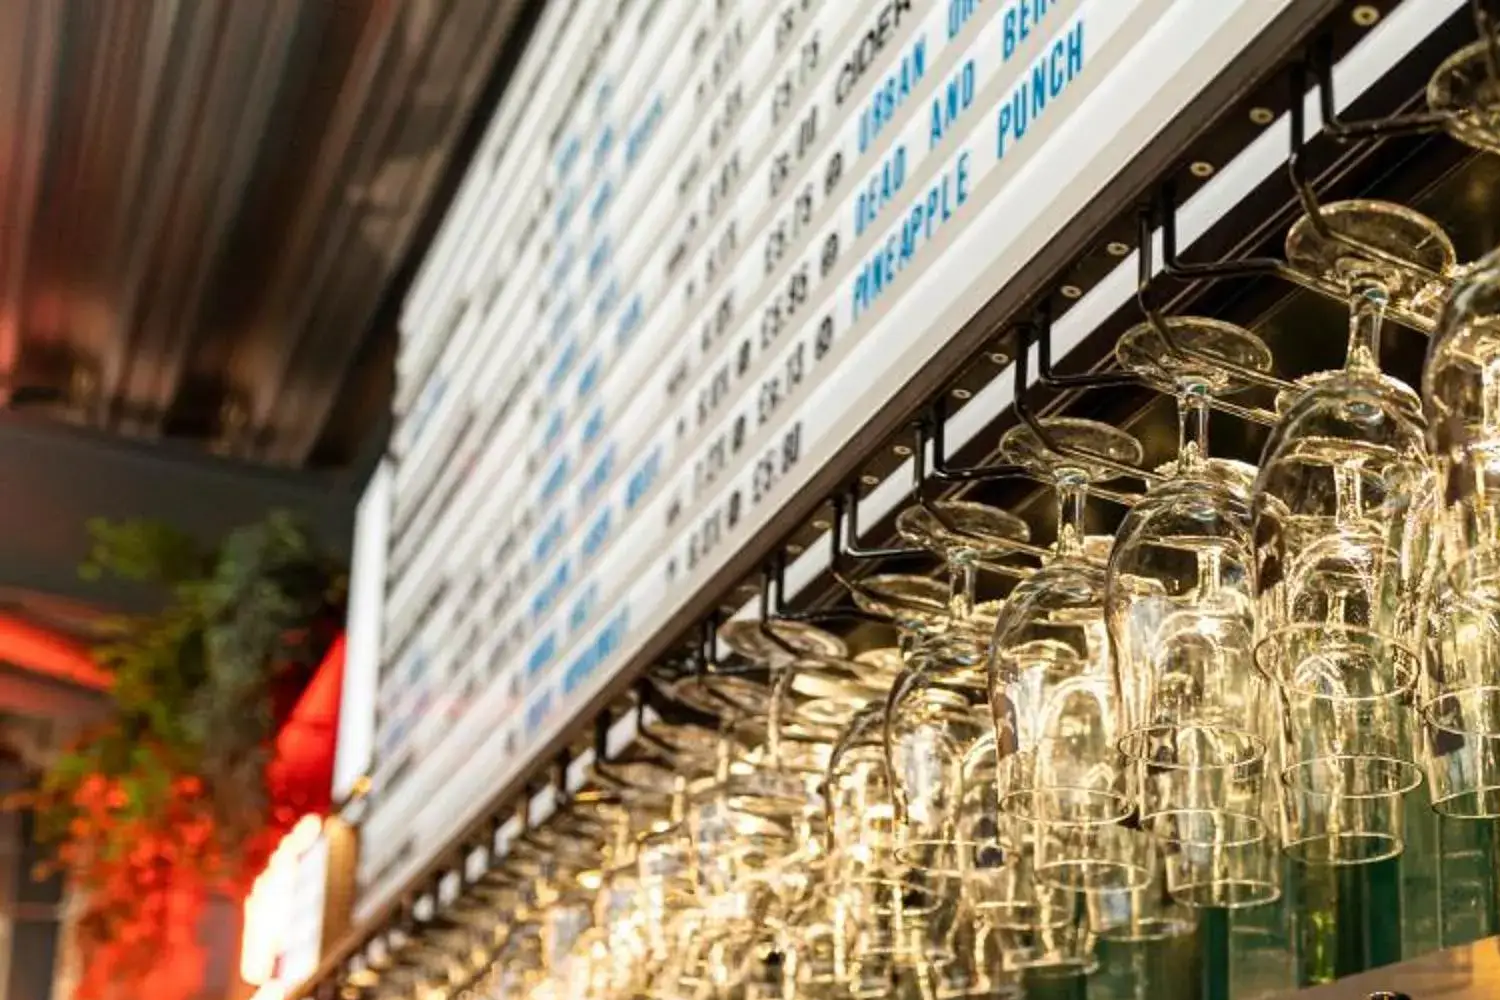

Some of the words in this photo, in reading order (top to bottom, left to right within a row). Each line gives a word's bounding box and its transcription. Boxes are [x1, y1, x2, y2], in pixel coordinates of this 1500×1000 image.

[853, 150, 970, 322] PINEAPPLE
[997, 19, 1084, 160] PUNCH
[855, 144, 906, 237] DEAD
[930, 58, 976, 150] AND
[857, 33, 927, 154] URBAN
